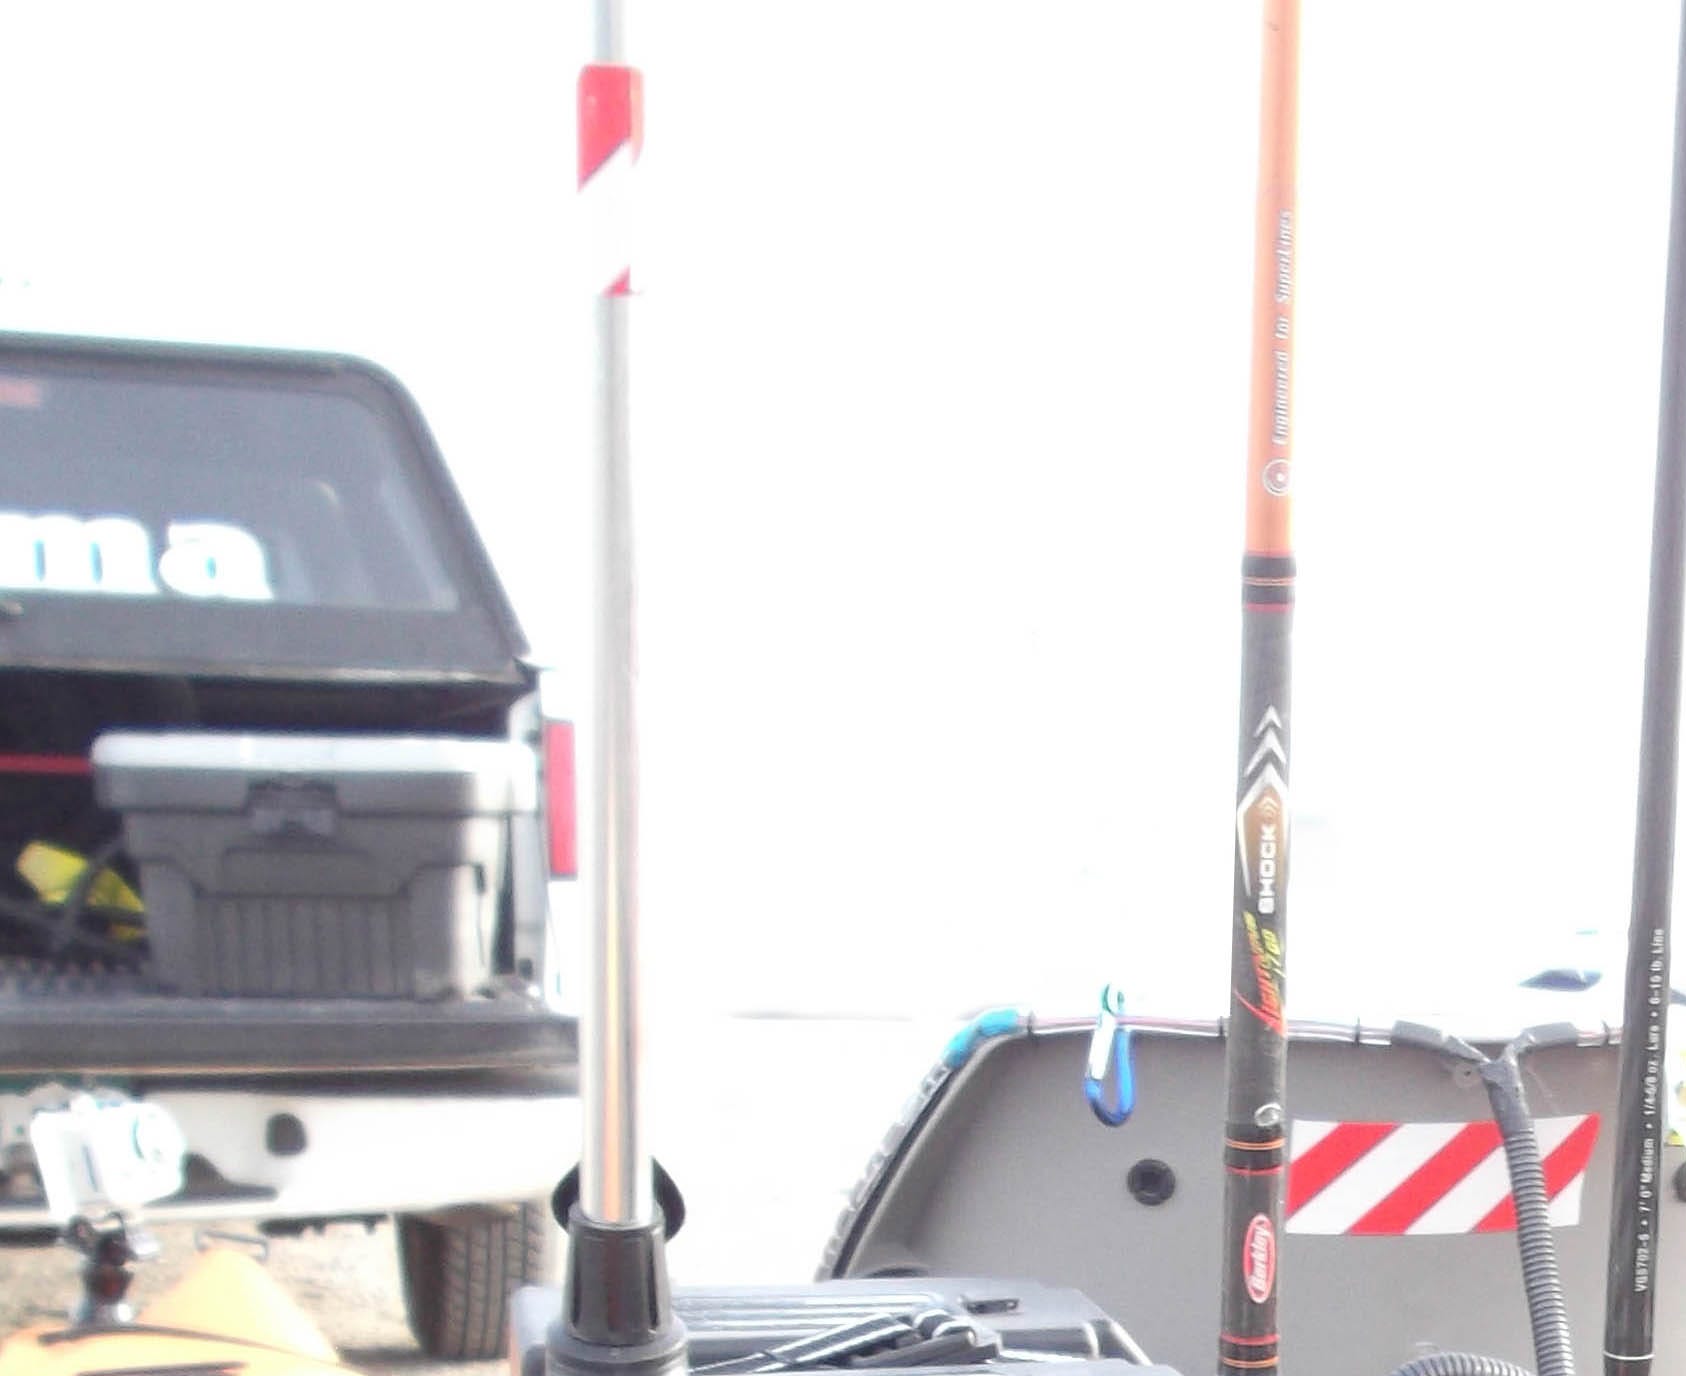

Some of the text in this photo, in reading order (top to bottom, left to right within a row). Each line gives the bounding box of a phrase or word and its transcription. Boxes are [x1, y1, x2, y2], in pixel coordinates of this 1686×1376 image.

[1257, 824, 1277, 914] SHOCK
[1650, 928, 1665, 954] Line
[1645, 1025, 1659, 1050] Lure
[1640, 1138, 1654, 1183] Medium
[1248, 1226, 1271, 1292] Berkley
